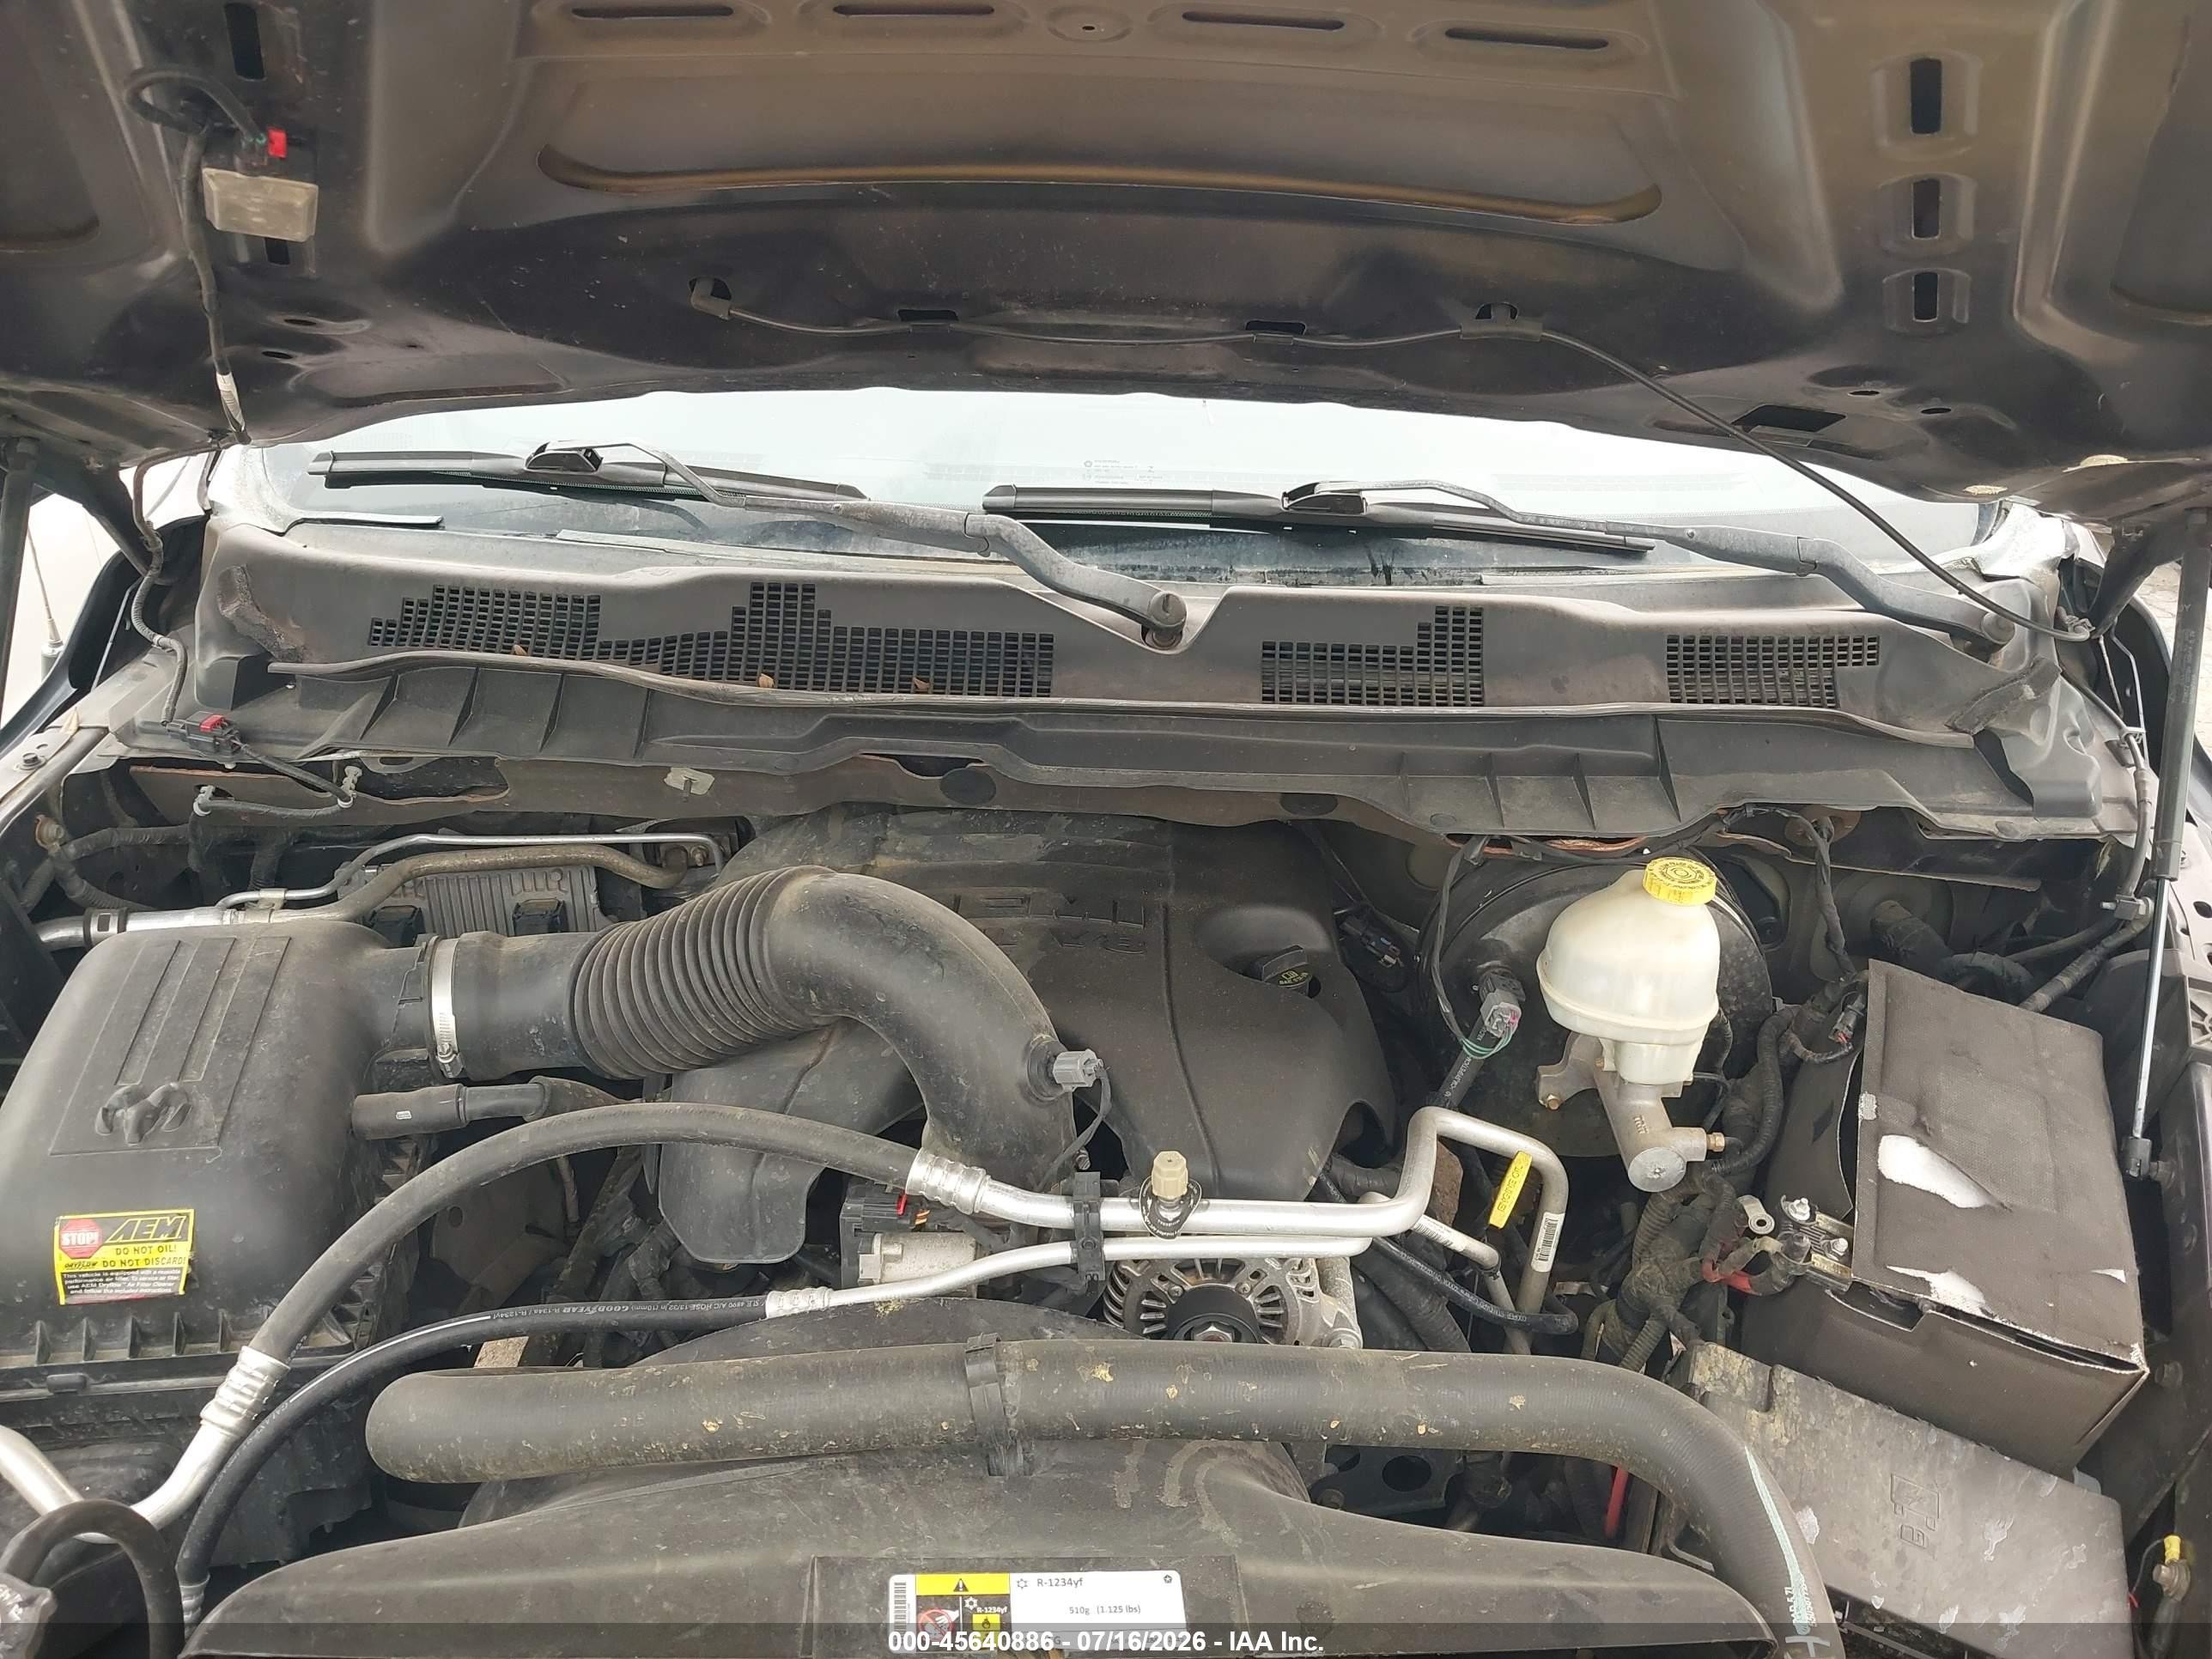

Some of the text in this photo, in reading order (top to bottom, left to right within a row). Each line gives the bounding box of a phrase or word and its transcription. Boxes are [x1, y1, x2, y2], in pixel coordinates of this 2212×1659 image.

[1511, 1164, 1524, 1179] OIL
[105, 1215, 187, 1243] AEM
[64, 1231, 98, 1245] STOP!
[134, 1246, 153, 1255] NOT
[158, 1244, 177, 1254] OIL!
[120, 1259, 139, 1267] NOT
[145, 1256, 186, 1266] DISCARD!
[562, 1305, 629, 1315] GOODYEAR
[1036, 1577, 1084, 1589] R-1234yf
[976, 1605, 1008, 1615] R-1234yf
[1069, 1603, 1141, 1615] 510g (1.125 lbs)
